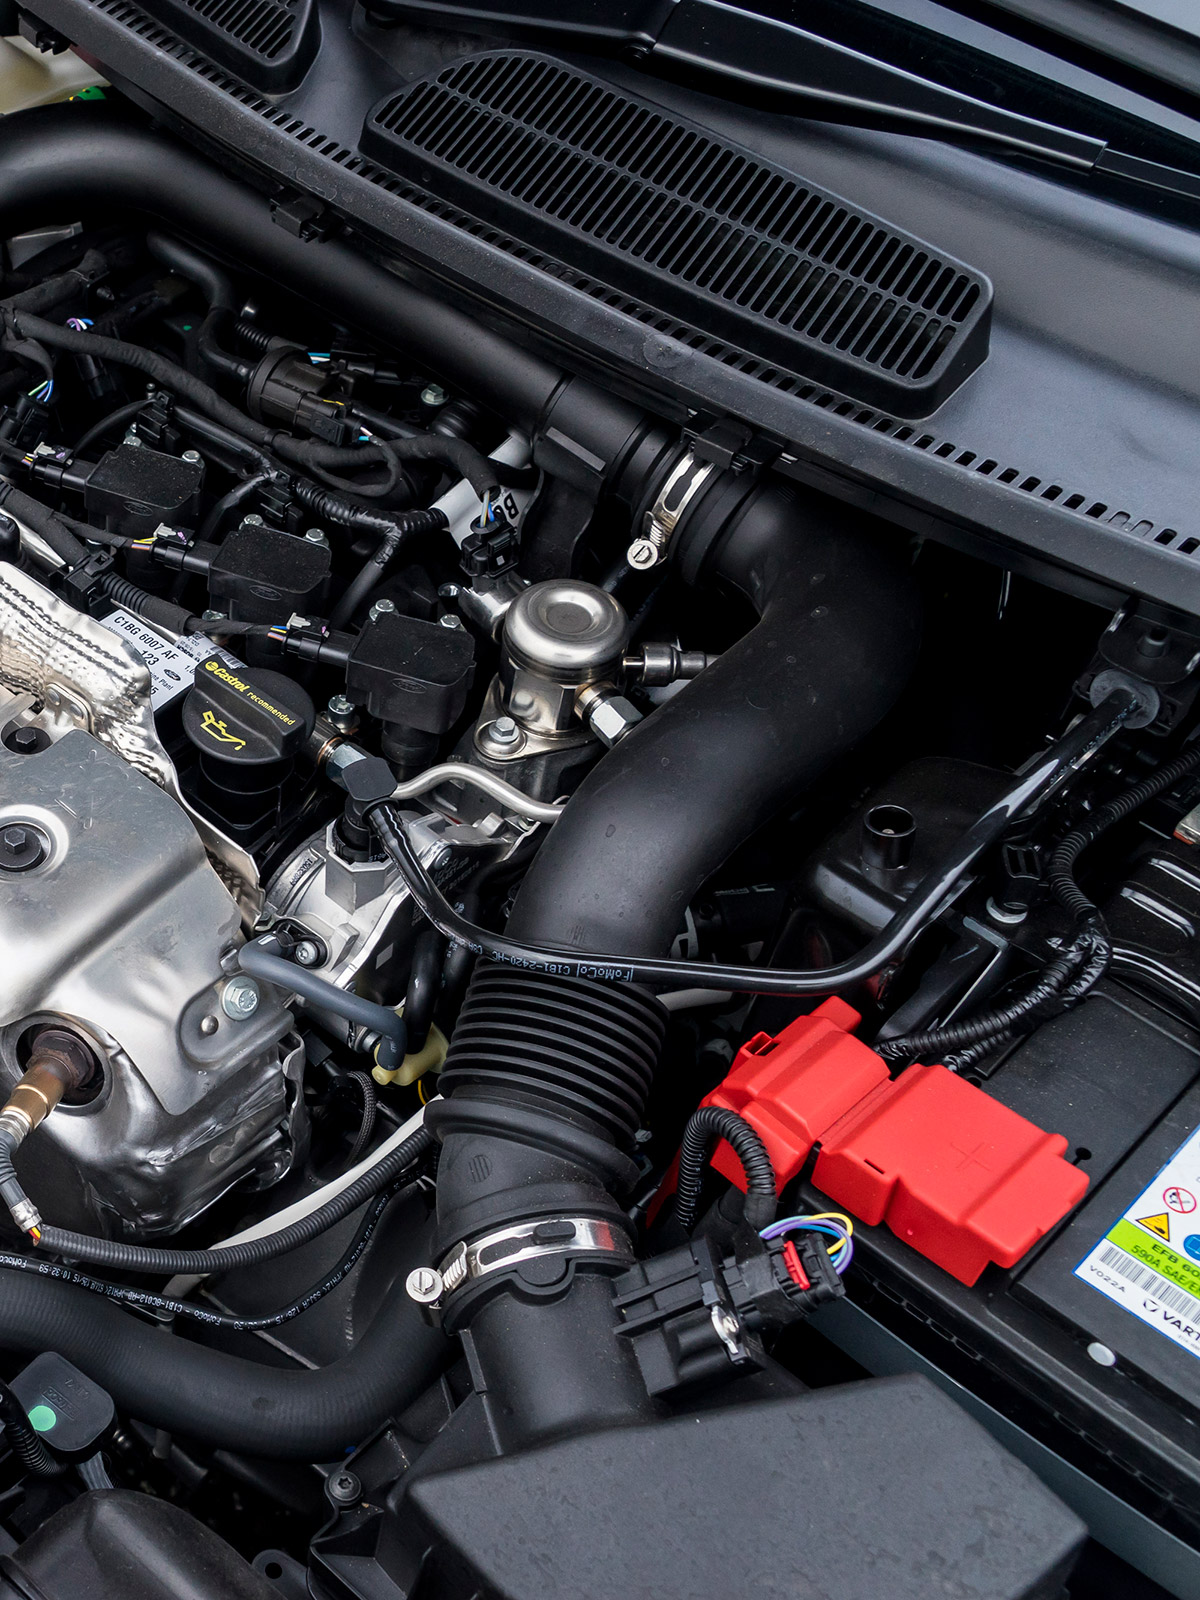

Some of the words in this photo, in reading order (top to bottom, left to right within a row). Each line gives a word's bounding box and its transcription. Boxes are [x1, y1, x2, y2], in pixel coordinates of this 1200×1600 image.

[138, 633, 164, 651] 6007
[161, 650, 179, 661] AF
[214, 668, 250, 692] Castrol
[246, 692, 296, 726] recommended
[580, 965, 630, 981] FoMoCo
[1131, 1244, 1160, 1268] 590A
[1152, 1243, 1179, 1264] EFB
